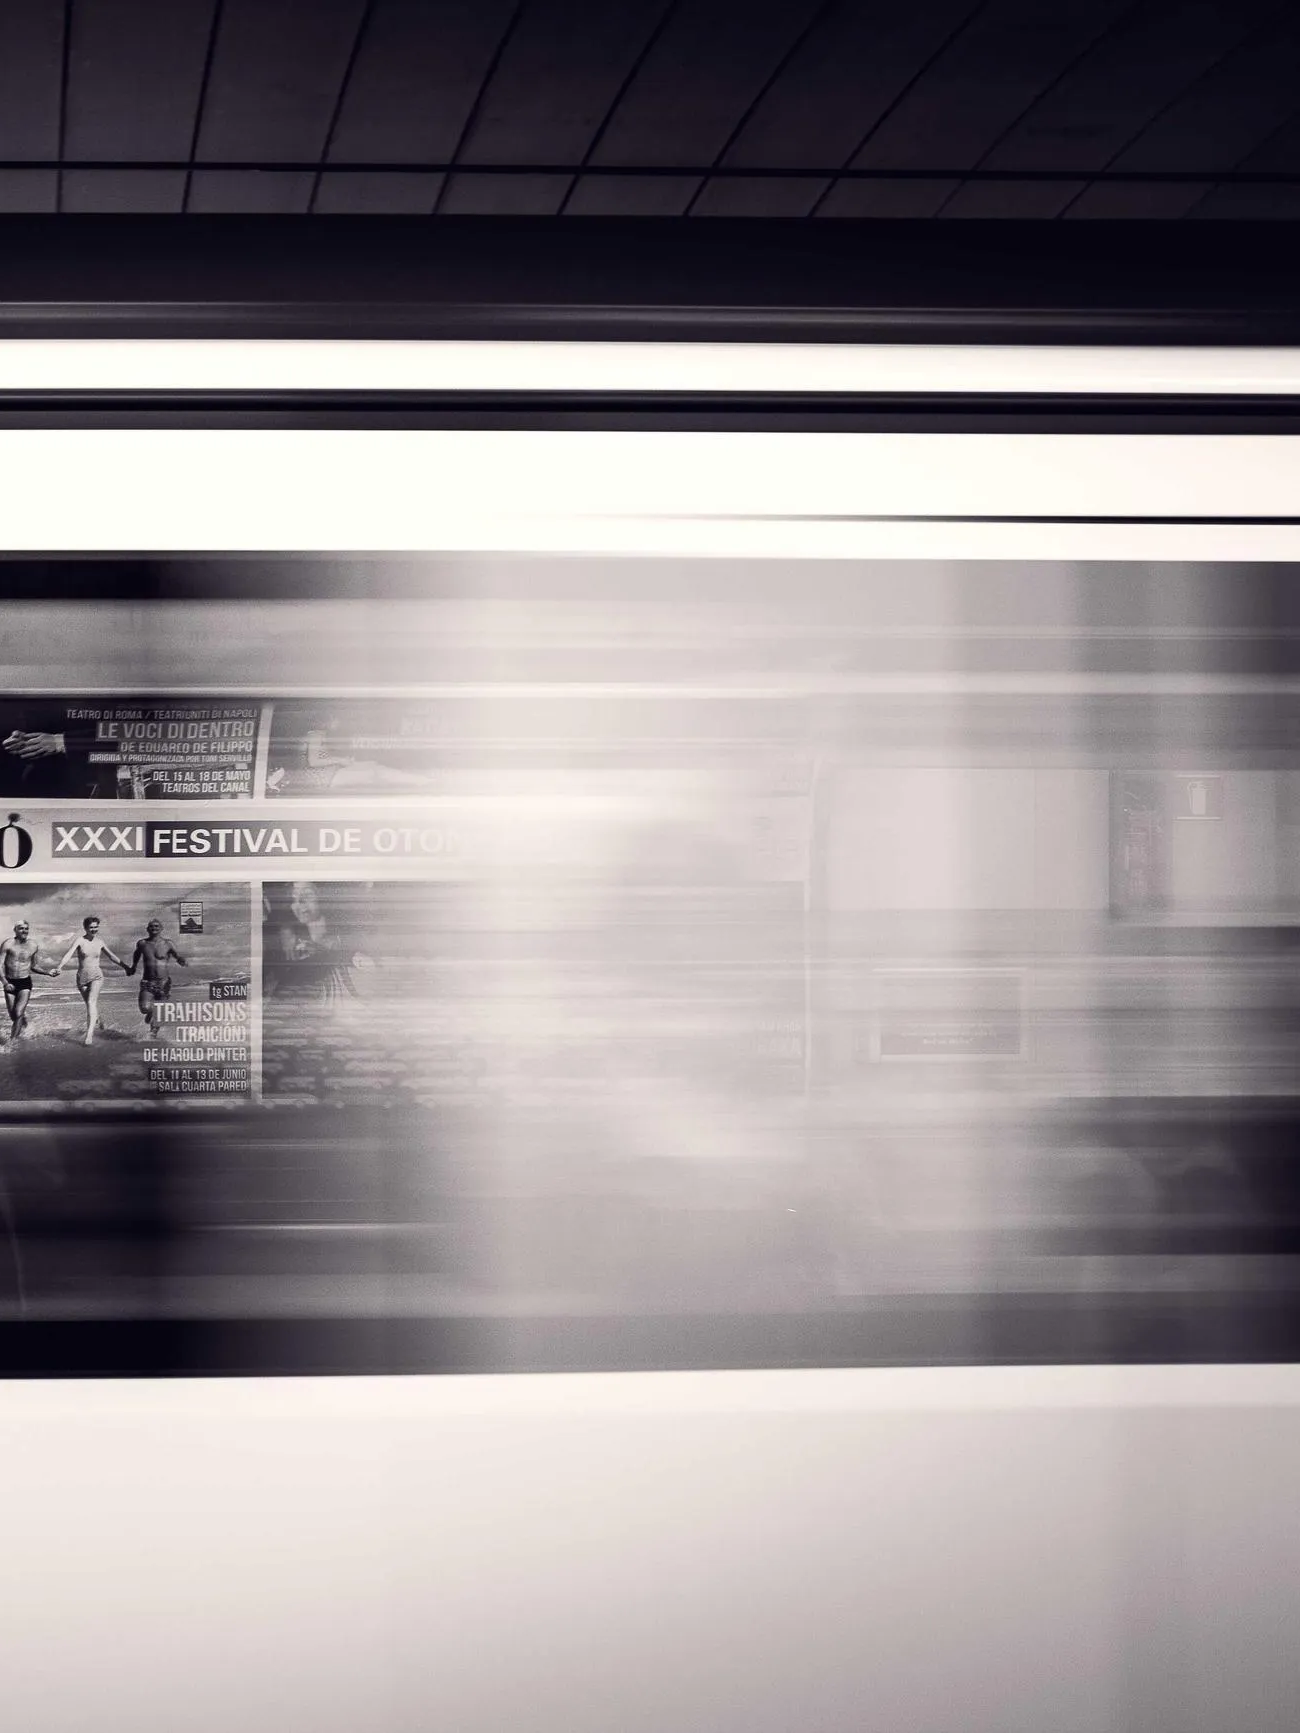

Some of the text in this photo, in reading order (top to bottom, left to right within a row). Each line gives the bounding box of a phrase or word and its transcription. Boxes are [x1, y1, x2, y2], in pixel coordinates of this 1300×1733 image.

[67, 709, 100, 719] TEATRO
[103, 709, 113, 719] DI
[115, 709, 142, 719] ROMA
[223, 709, 257, 719] NAPOLI
[98, 721, 255, 739] LE VOCI DI DENTRO
[120, 741, 135, 753] DE
[193, 741, 207, 753] DE
[210, 741, 253, 753] FILIPPO
[153, 771, 170, 781] DEL
[184, 771, 196, 781] AL
[200, 771, 210, 781] 18
[211, 771, 224, 781] DE
[225, 771, 250, 781] MAYO
[162, 782, 250, 793] TEATROS DEL CANAL
[54, 826, 143, 851] XXXI
[153, 828, 308, 854] FESTIVAL
[319, 828, 361, 853] DE
[212, 985, 247, 998] tg STAN
[154, 1002, 247, 1022] TRAHISONS
[143, 1048, 247, 1062] DE HAROLD PINTER
[150, 1069, 168, 1080] DEL
[181, 1069, 192, 1080] AL
[196, 1069, 206, 1080] 13
[208, 1069, 220, 1080] DE
[222, 1069, 247, 1080] JUNIO
[181, 1081, 216, 1091] CUARTA
[218, 1081, 247, 1091] PARED
